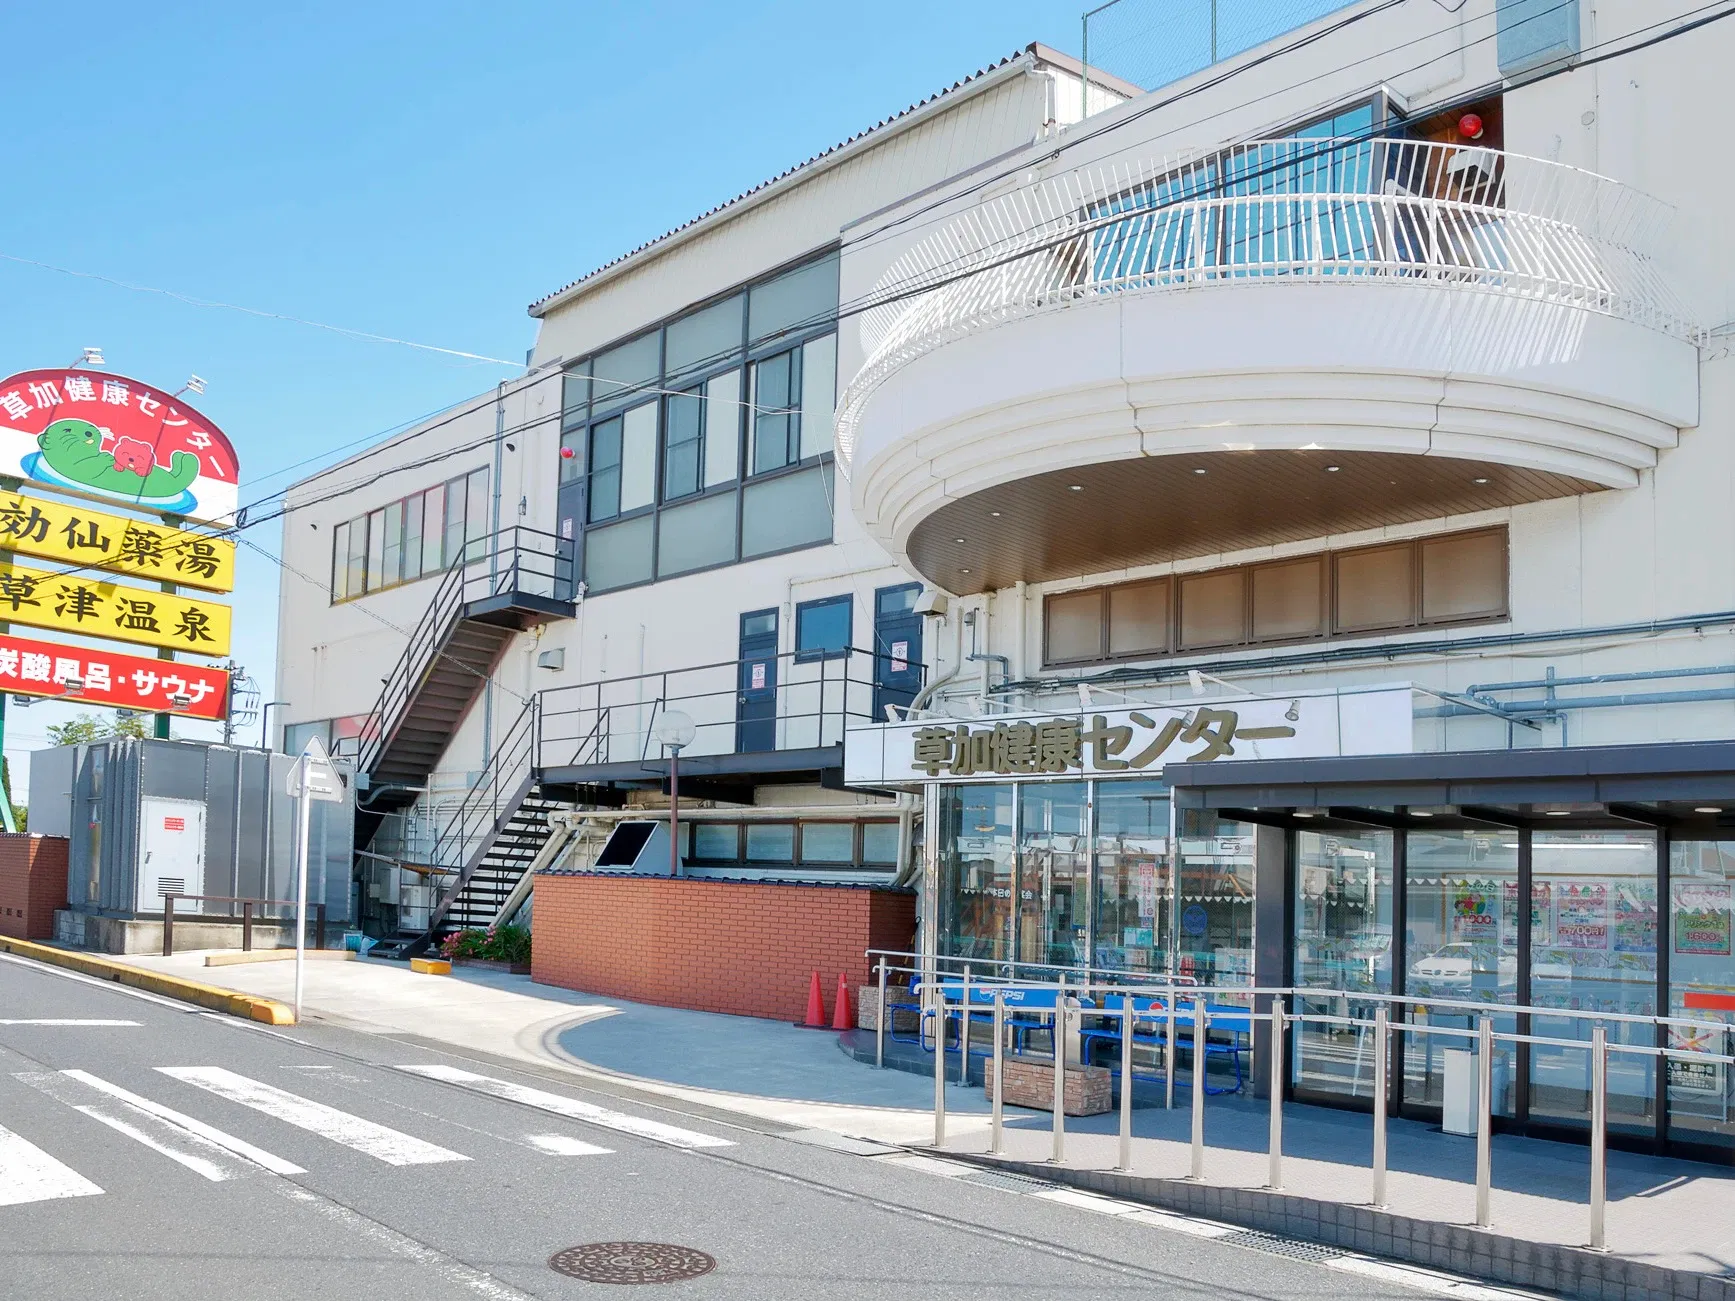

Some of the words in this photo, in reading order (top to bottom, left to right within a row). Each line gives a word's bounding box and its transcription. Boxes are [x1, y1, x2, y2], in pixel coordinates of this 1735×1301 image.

[1, 375, 226, 478] 草加健康センター
[0, 501, 221, 579] 効仙薬湯
[0, 573, 216, 642] 草津温泉
[0, 647, 214, 704] 炭酸風呂・サウナ
[912, 707, 1296, 778] 草加健康センター
